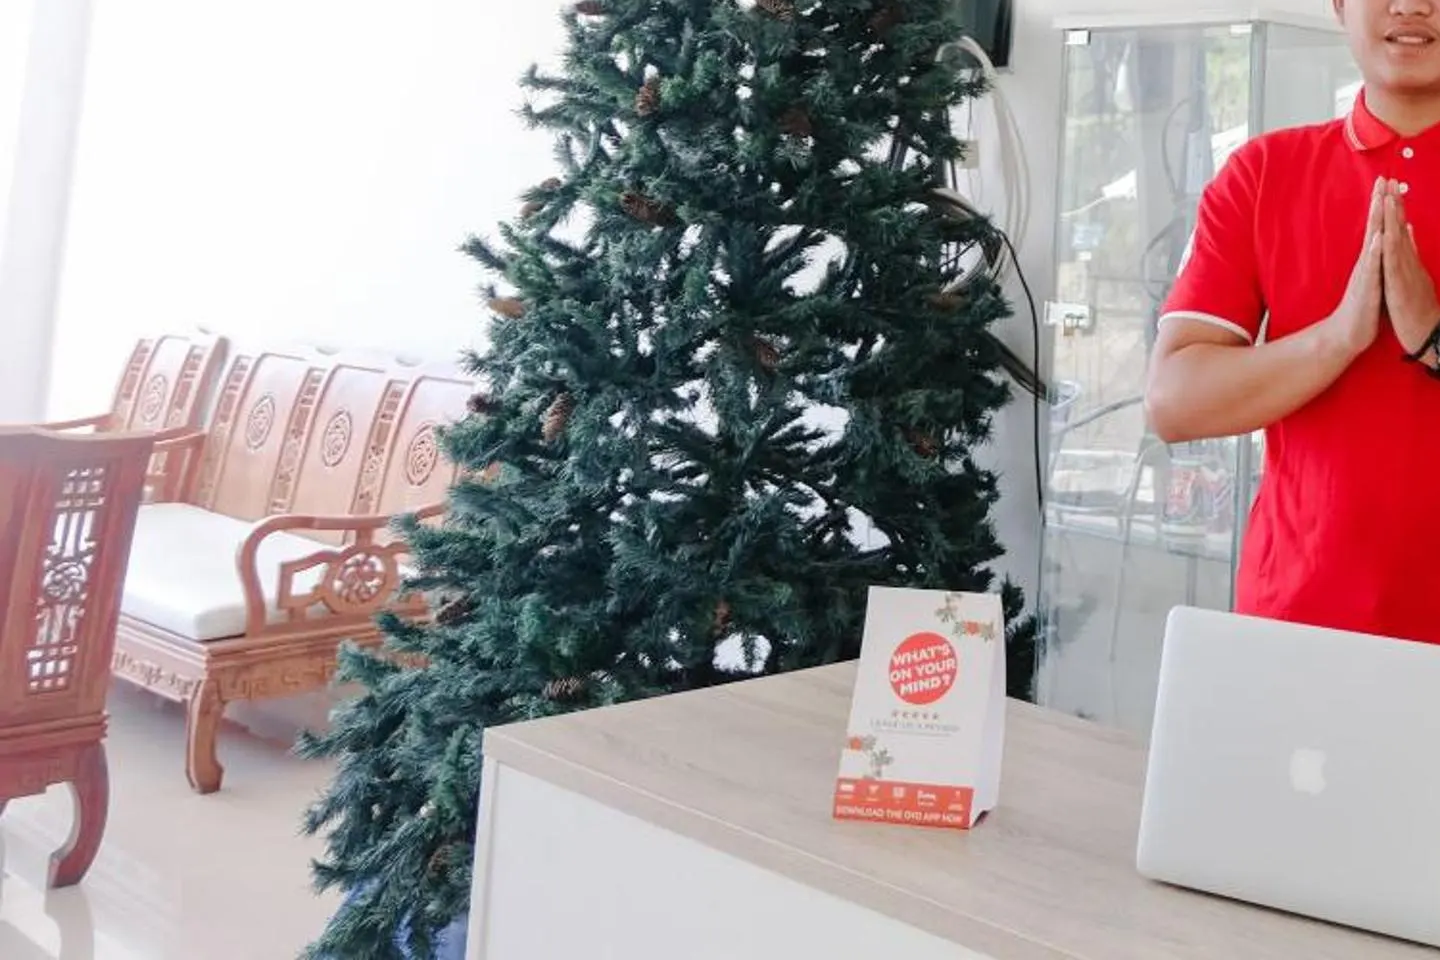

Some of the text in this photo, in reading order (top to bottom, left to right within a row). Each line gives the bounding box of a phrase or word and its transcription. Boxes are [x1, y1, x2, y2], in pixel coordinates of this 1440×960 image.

[893, 643, 951, 665] WHAT'S
[890, 658, 956, 683] ON YOUR
[900, 673, 951, 696] MIND?
